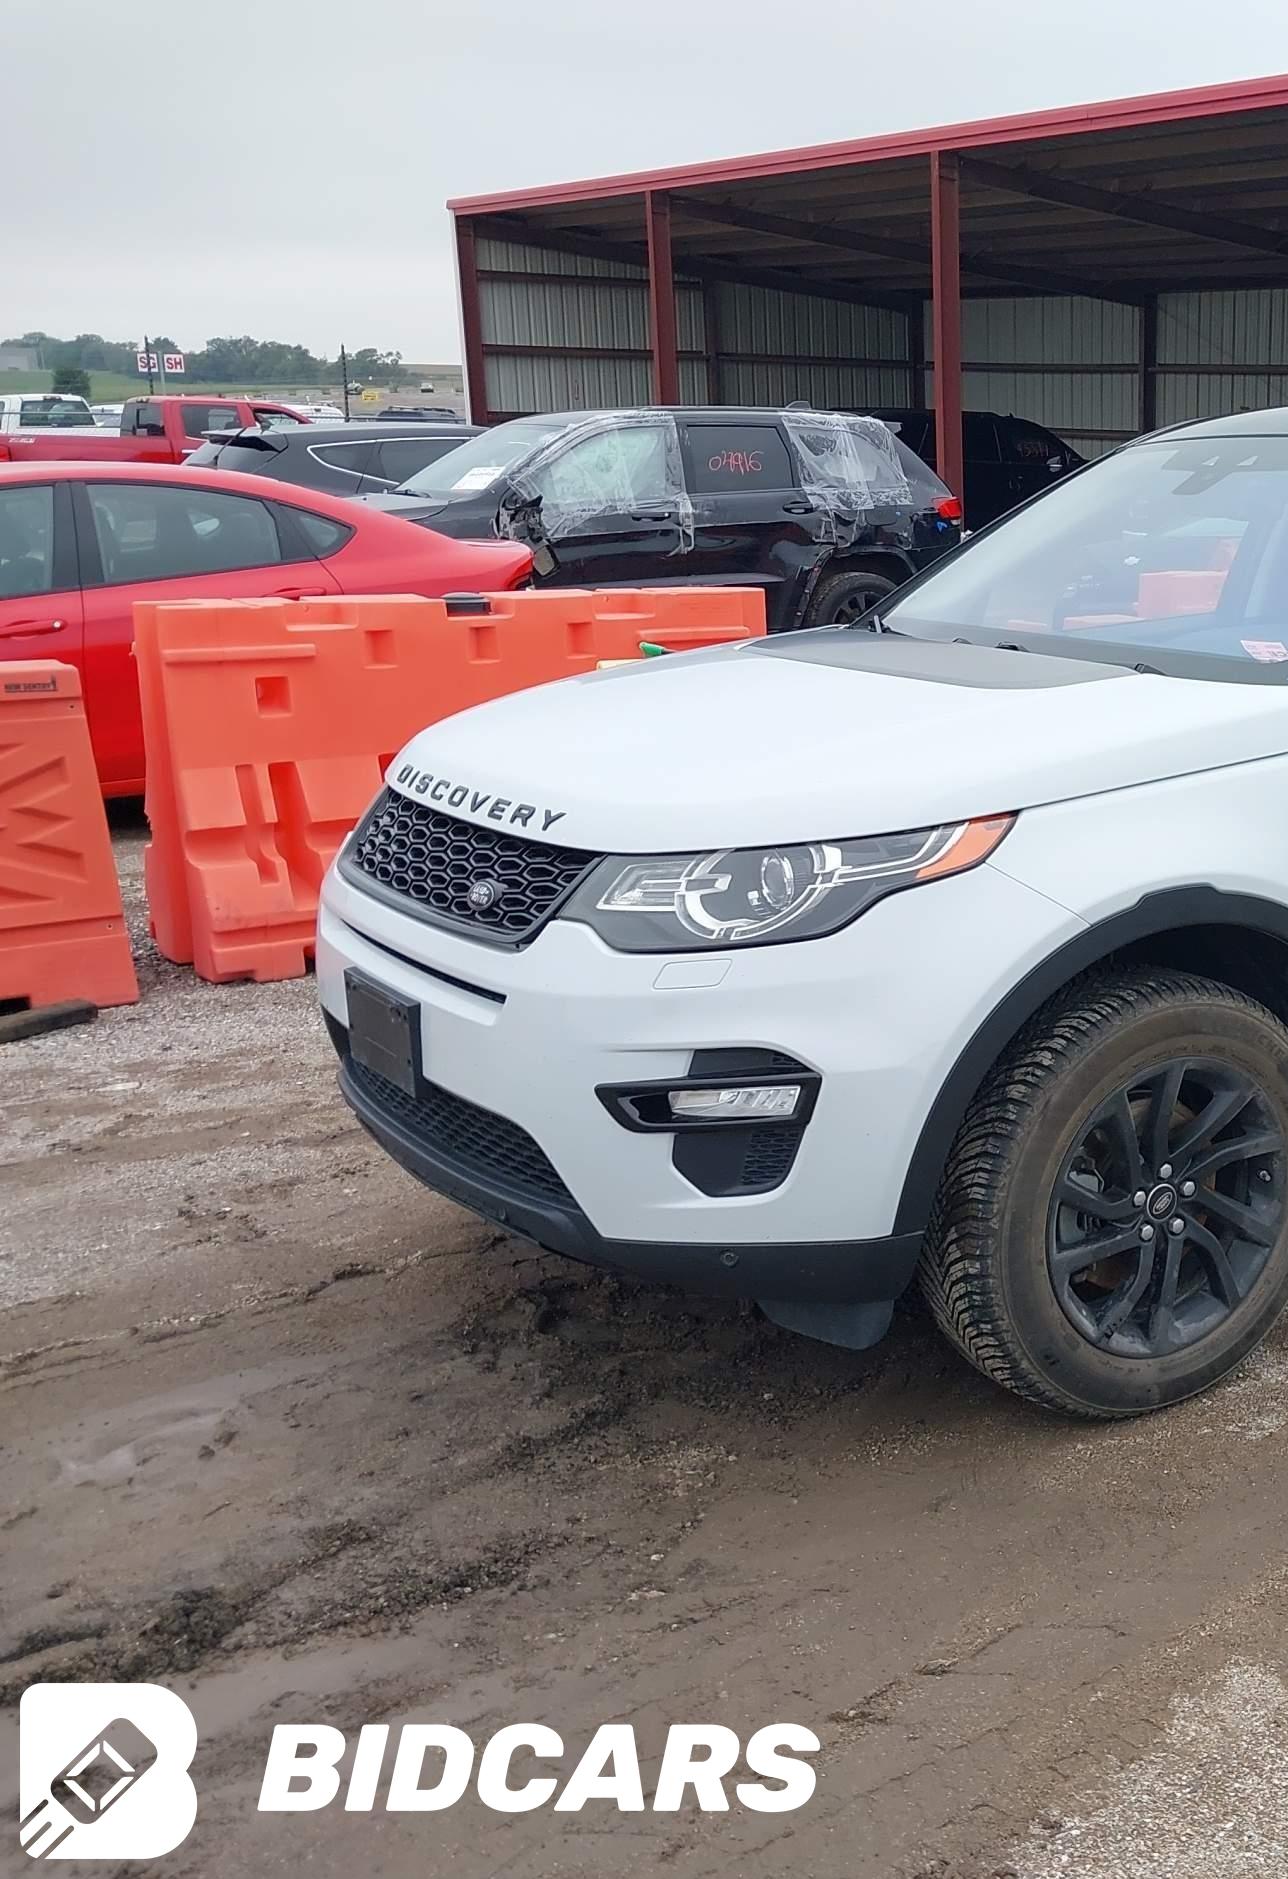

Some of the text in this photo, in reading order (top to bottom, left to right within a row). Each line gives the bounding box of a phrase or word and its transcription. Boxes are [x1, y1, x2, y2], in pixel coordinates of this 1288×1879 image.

[139, 355, 157, 369] SG
[166, 356, 183, 370] SH
[396, 763, 567, 832] DISCOVERY
